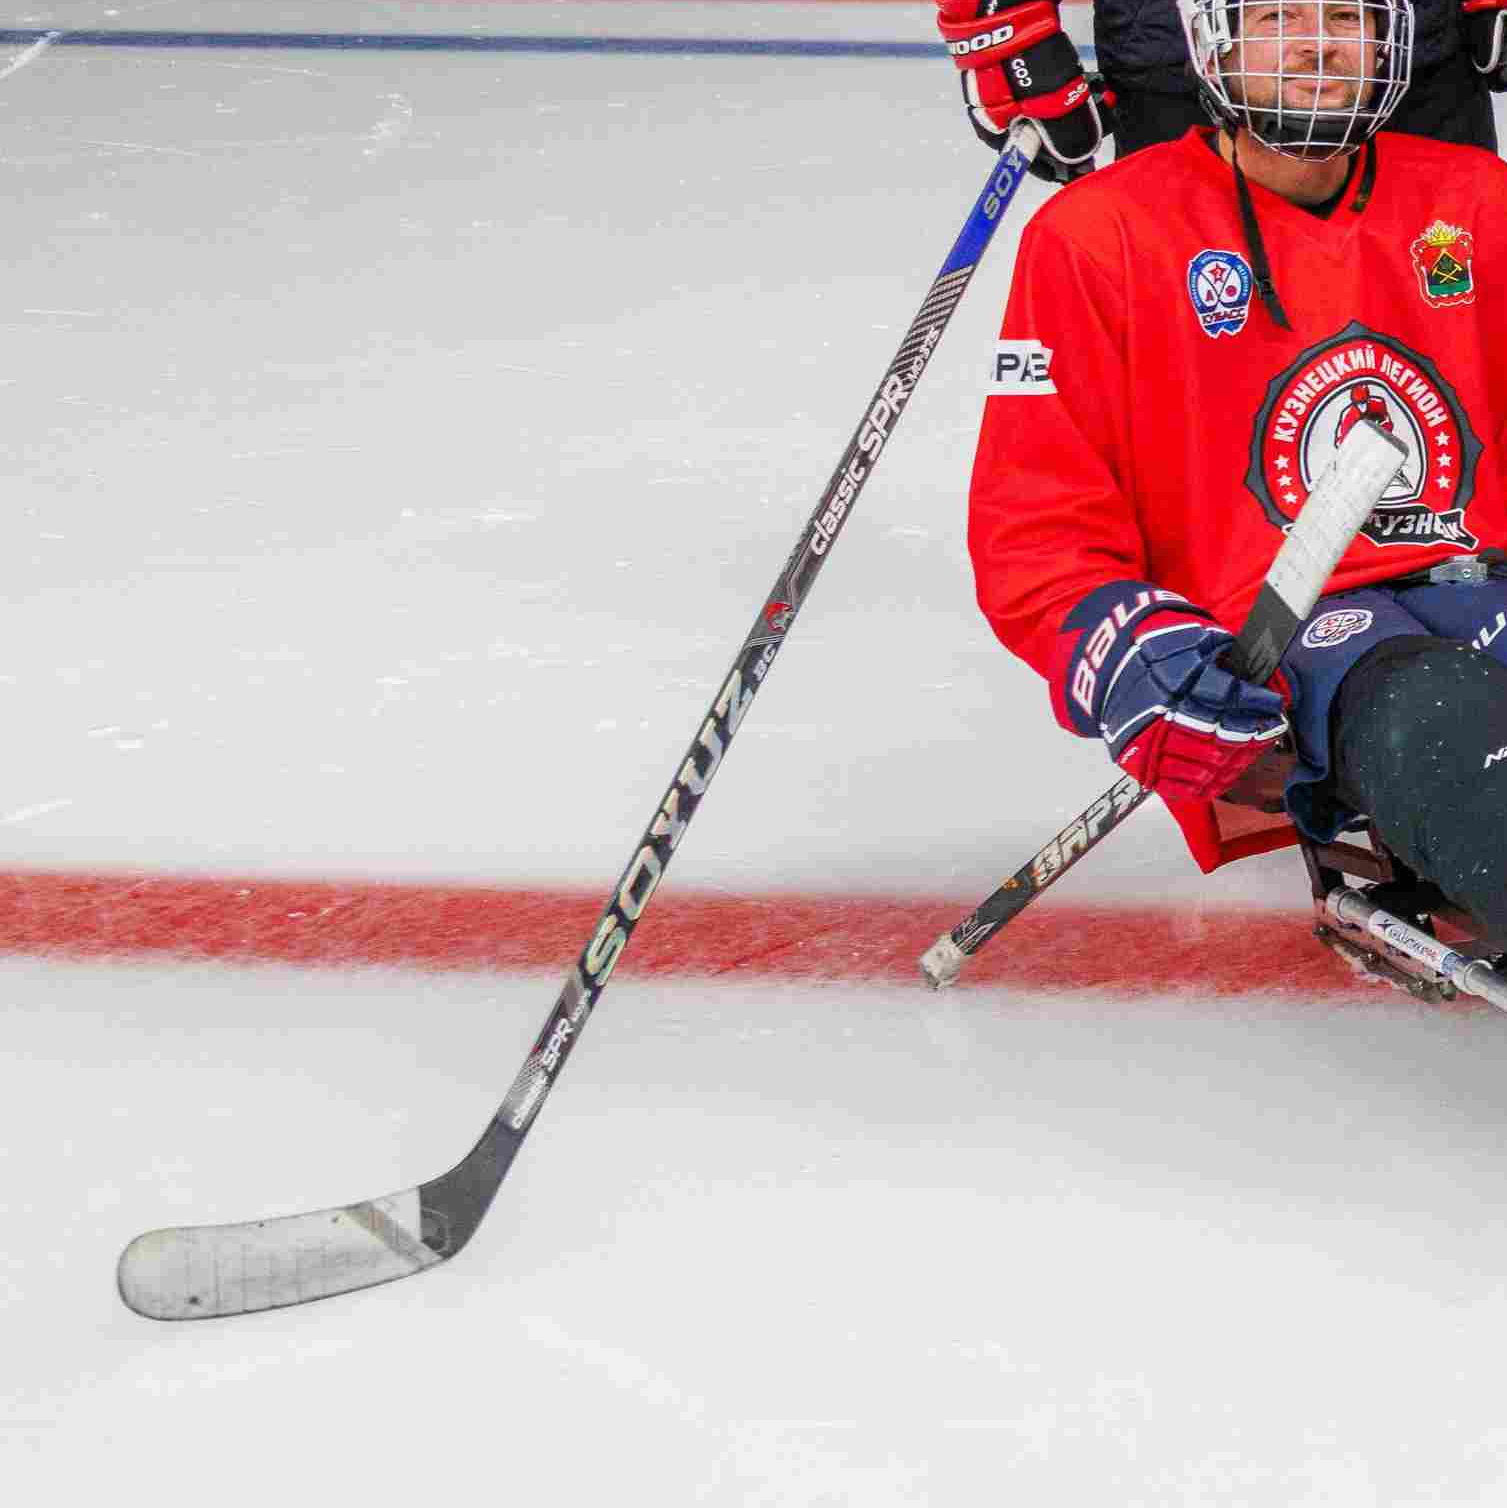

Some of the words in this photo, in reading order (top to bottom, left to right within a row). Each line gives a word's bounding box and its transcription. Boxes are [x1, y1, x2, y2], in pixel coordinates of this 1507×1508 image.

[808, 458, 866, 557] classic
[857, 372, 910, 462] SPR
[1271, 342, 1377, 444] КУЗНЕЦКИЙ
[1379, 348, 1447, 428] ЛЕГИОН
[585, 668, 755, 988] SOYUZ
